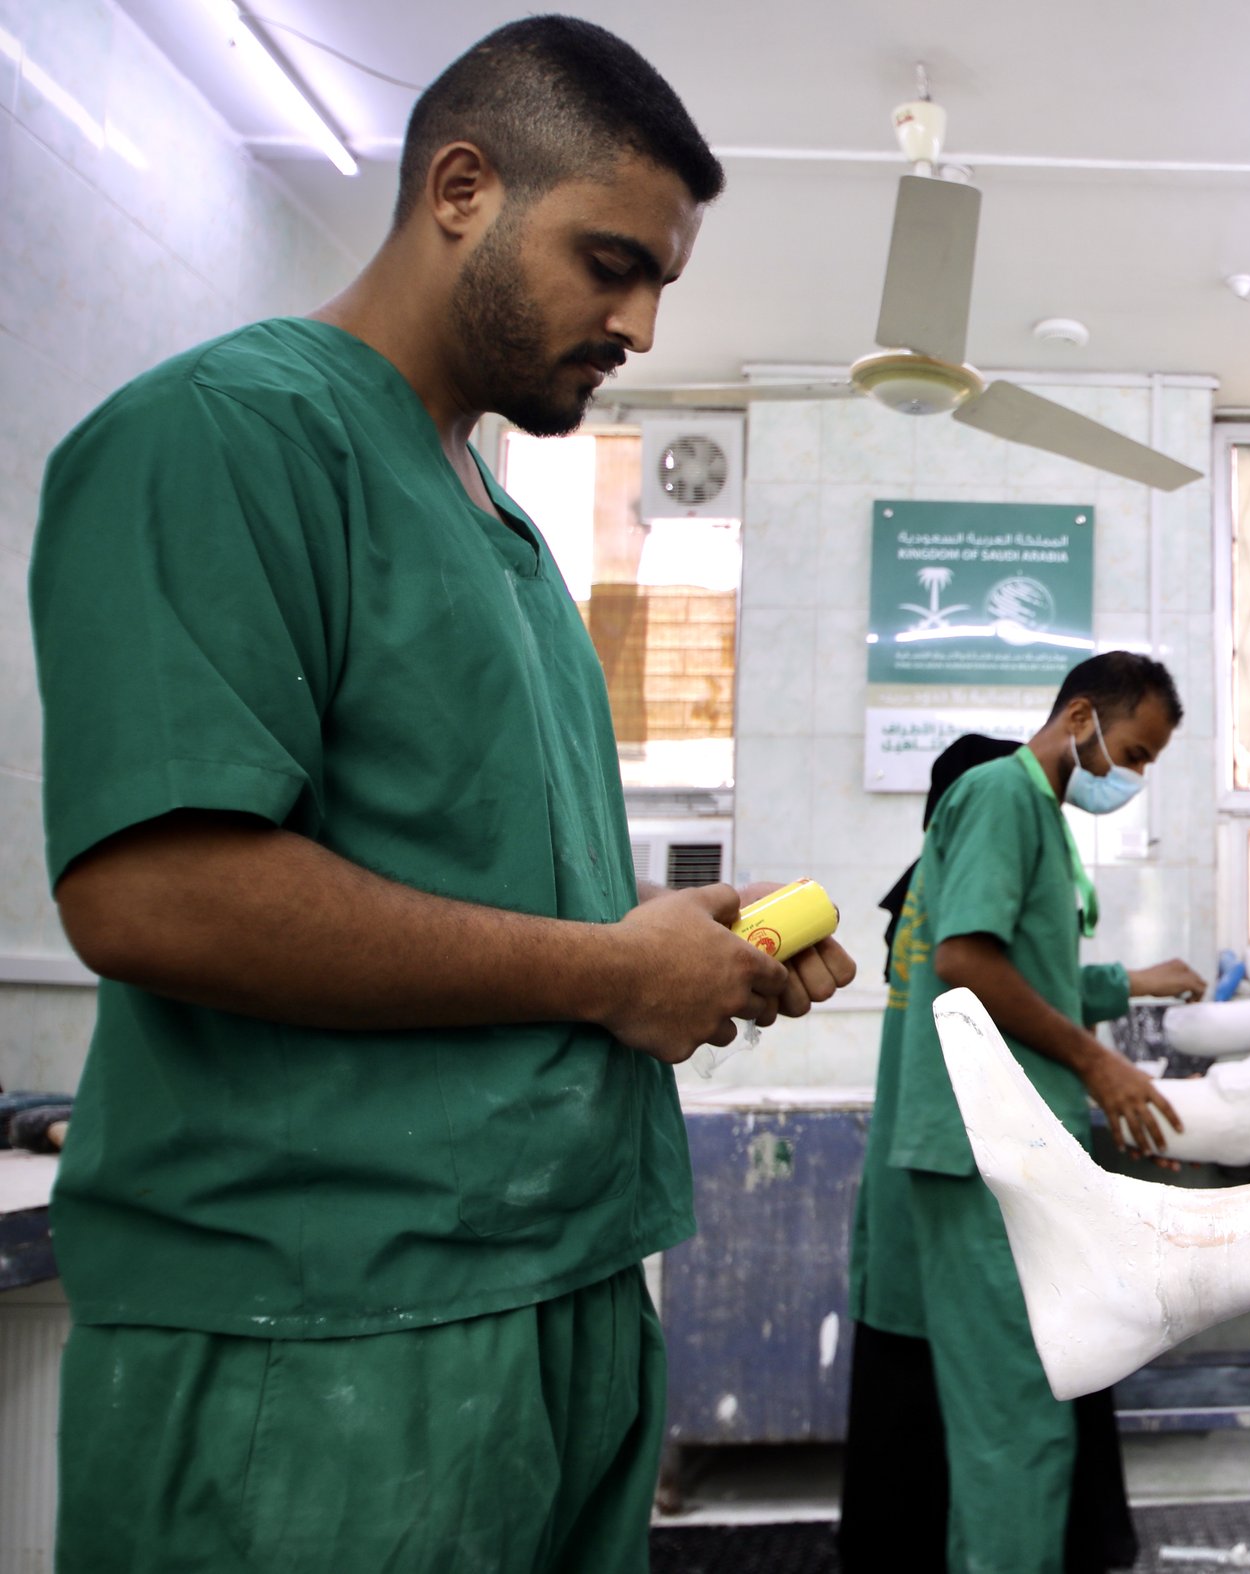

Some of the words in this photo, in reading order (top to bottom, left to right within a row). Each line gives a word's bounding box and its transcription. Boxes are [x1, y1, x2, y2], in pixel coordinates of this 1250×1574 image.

[897, 548, 960, 561] KINGDOM
[961, 548, 978, 561] OF
[981, 549, 1020, 562] SAUDI
[1021, 550, 1069, 563] ARABIA
